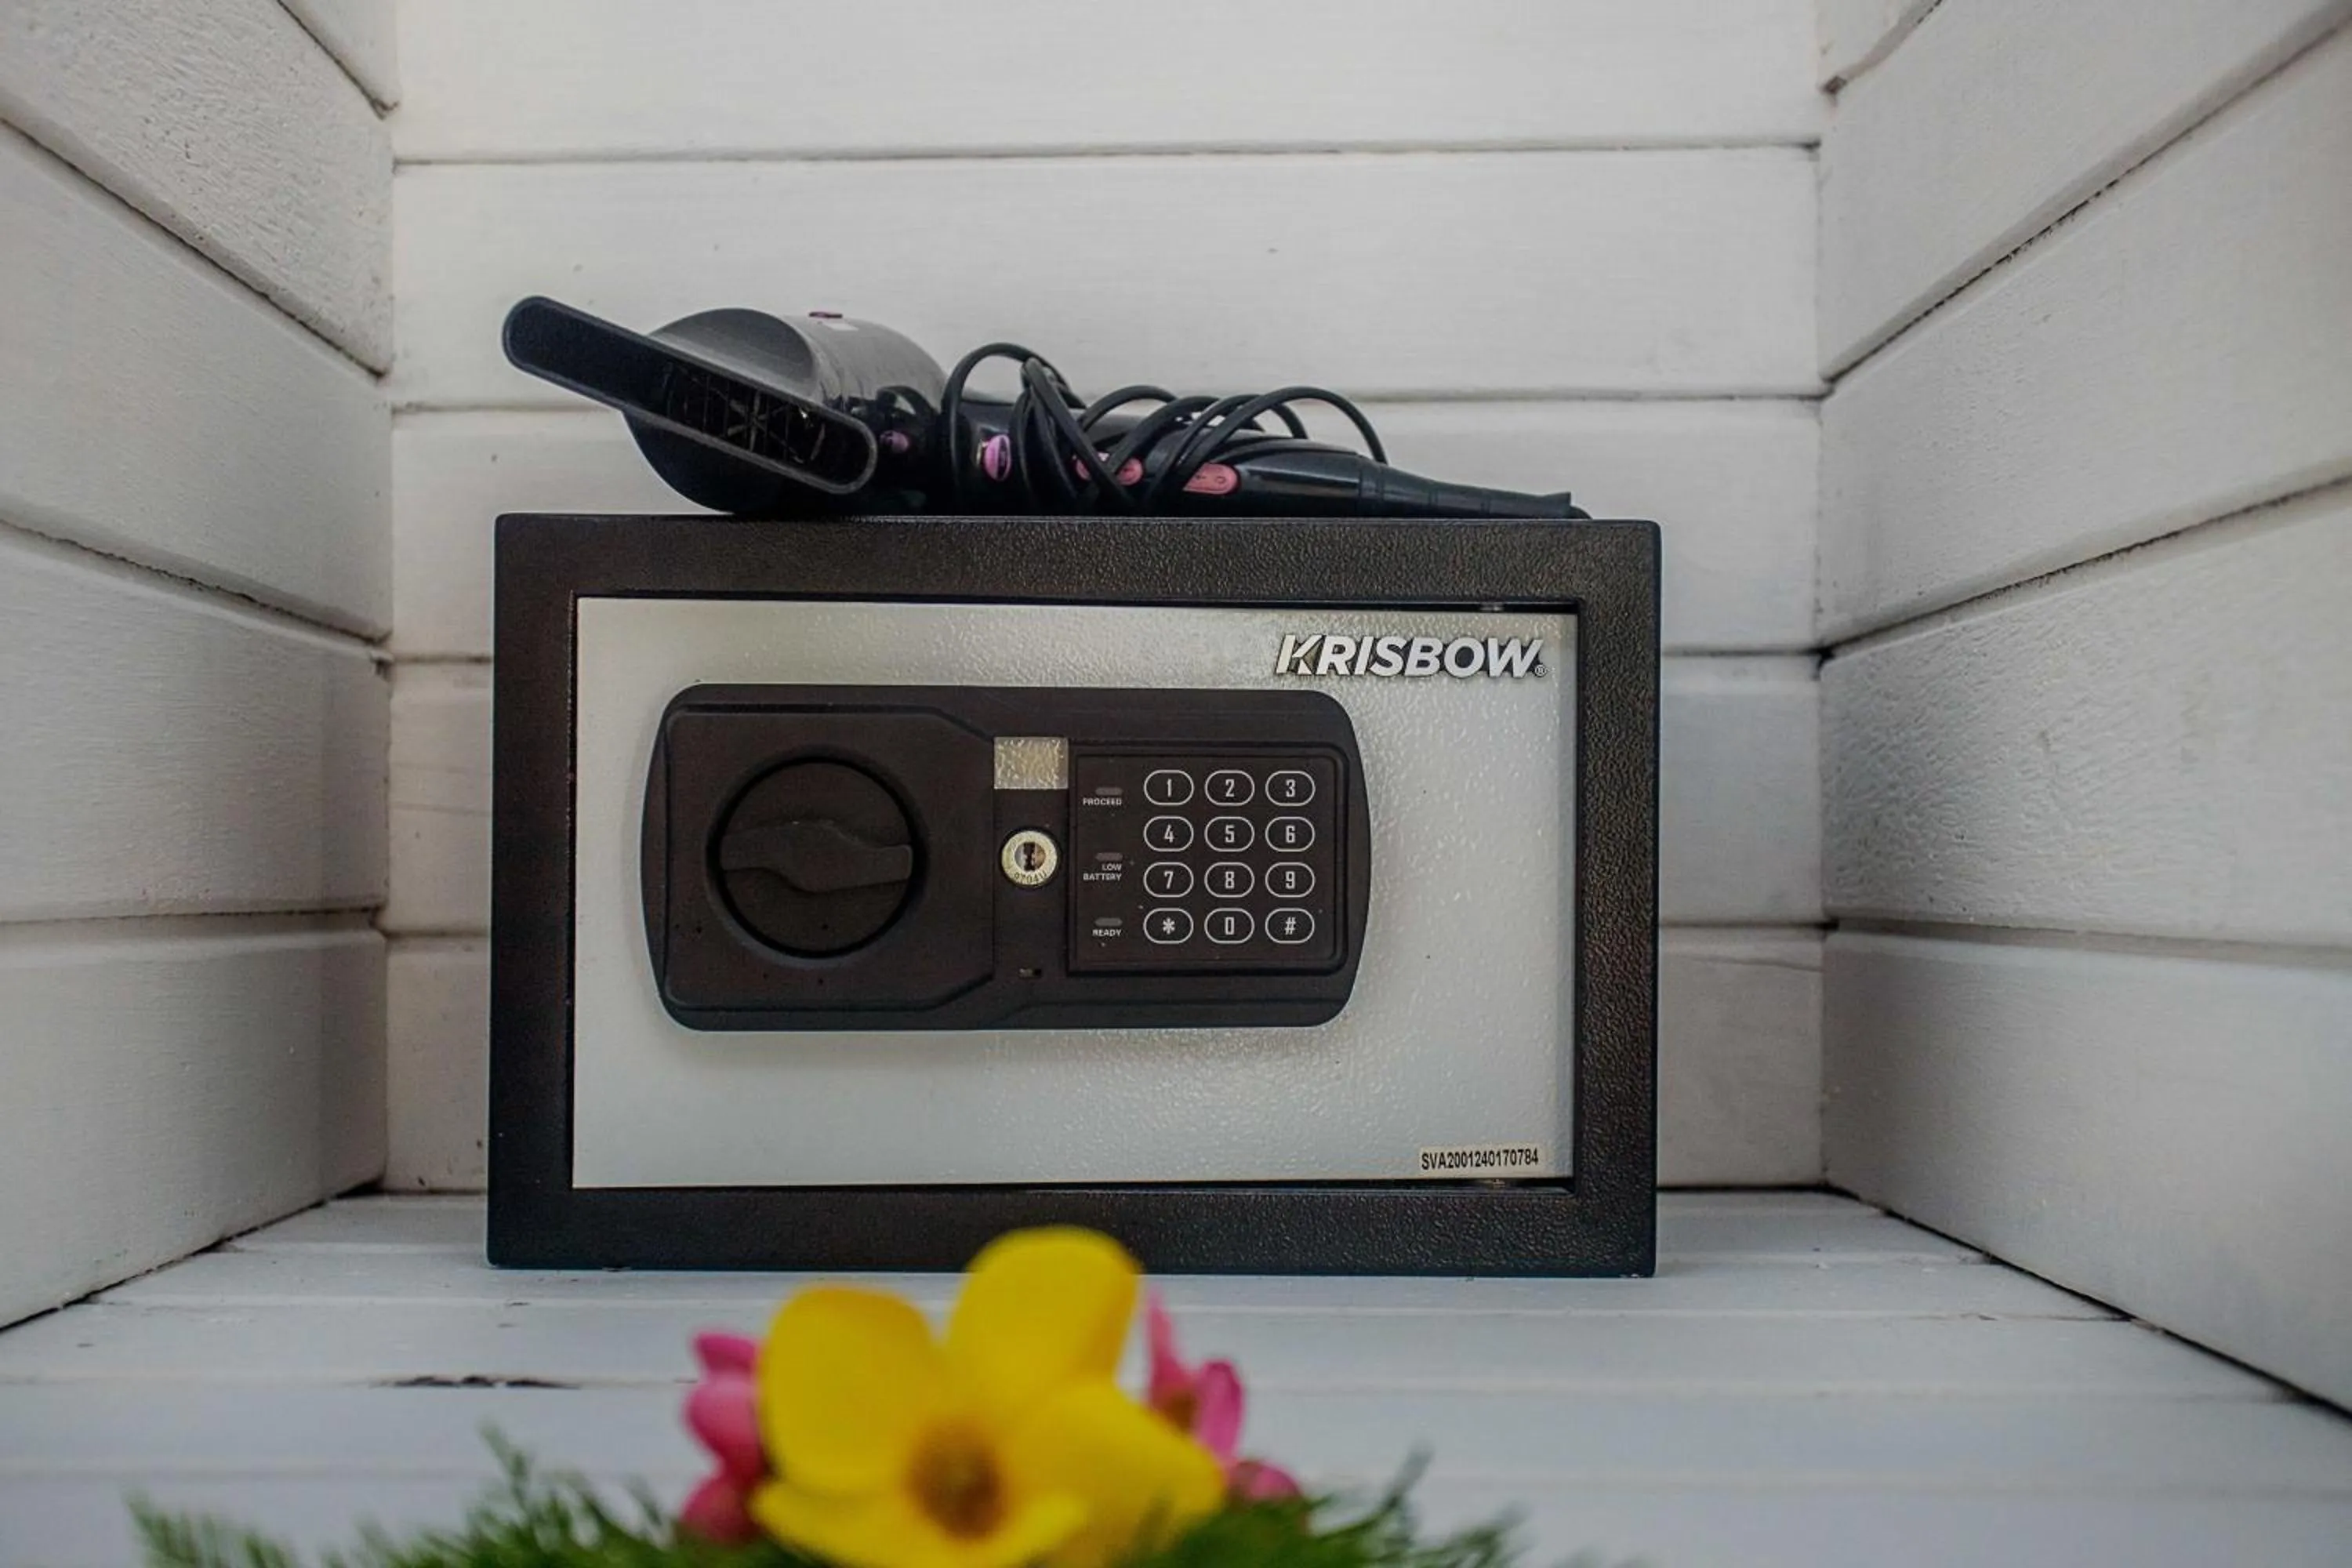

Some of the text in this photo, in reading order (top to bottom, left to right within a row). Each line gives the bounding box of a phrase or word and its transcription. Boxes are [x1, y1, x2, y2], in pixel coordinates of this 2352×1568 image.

[1167, 779, 1296, 797] 1 2 3
[1083, 797, 1122, 806] PROCEED
[1163, 824, 1296, 844] 4 5 6
[1102, 862, 1122, 871] LOW
[1083, 873, 1122, 881] BATTERY
[1163, 871, 1295, 889] 7 8 9
[1421, 1148, 1539, 1170] SVA2001240170784
